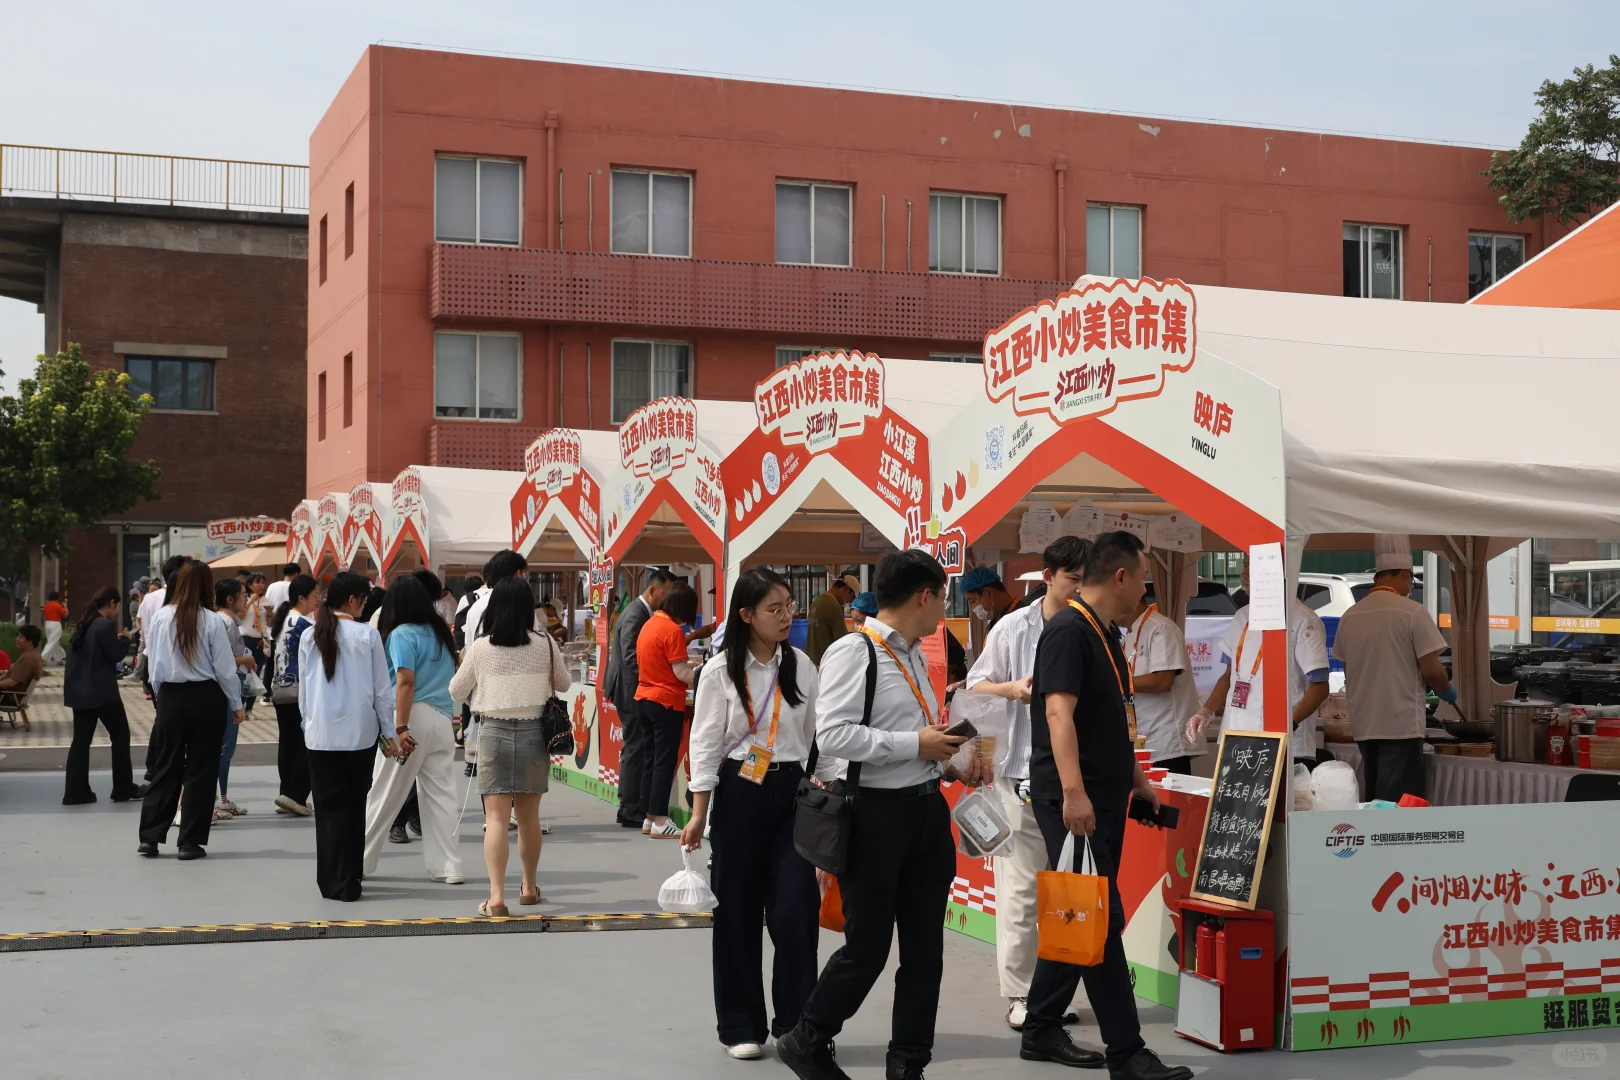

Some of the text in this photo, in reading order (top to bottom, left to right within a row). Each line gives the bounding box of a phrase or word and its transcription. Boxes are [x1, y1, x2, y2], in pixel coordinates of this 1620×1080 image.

[989, 295, 1188, 388] 江西小炒美食市集
[758, 362, 881, 427] 江西小炒美食市集
[1054, 357, 1116, 405] 江西小炒
[620, 407, 694, 459] 江西小炒美食市集
[1193, 390, 1233, 438] 映庐
[526, 437, 580, 478] 江西小炒美食市集
[883, 417, 917, 465] 小江溪
[1190, 435, 1217, 460] YINGLU
[695, 475, 721, 516] 江西小炒
[878, 449, 923, 504] 江西小炒
[210, 521, 292, 536] 江西小炒美食
[1325, 834, 1366, 848] CIFTIS
[1370, 830, 1465, 842] 中国国际服务贸易交易会
[1371, 868, 1528, 914] 人间烟火味
[1442, 914, 1620, 949] 江西小炒美食市集
[1543, 995, 1620, 1030] 逛服贸
